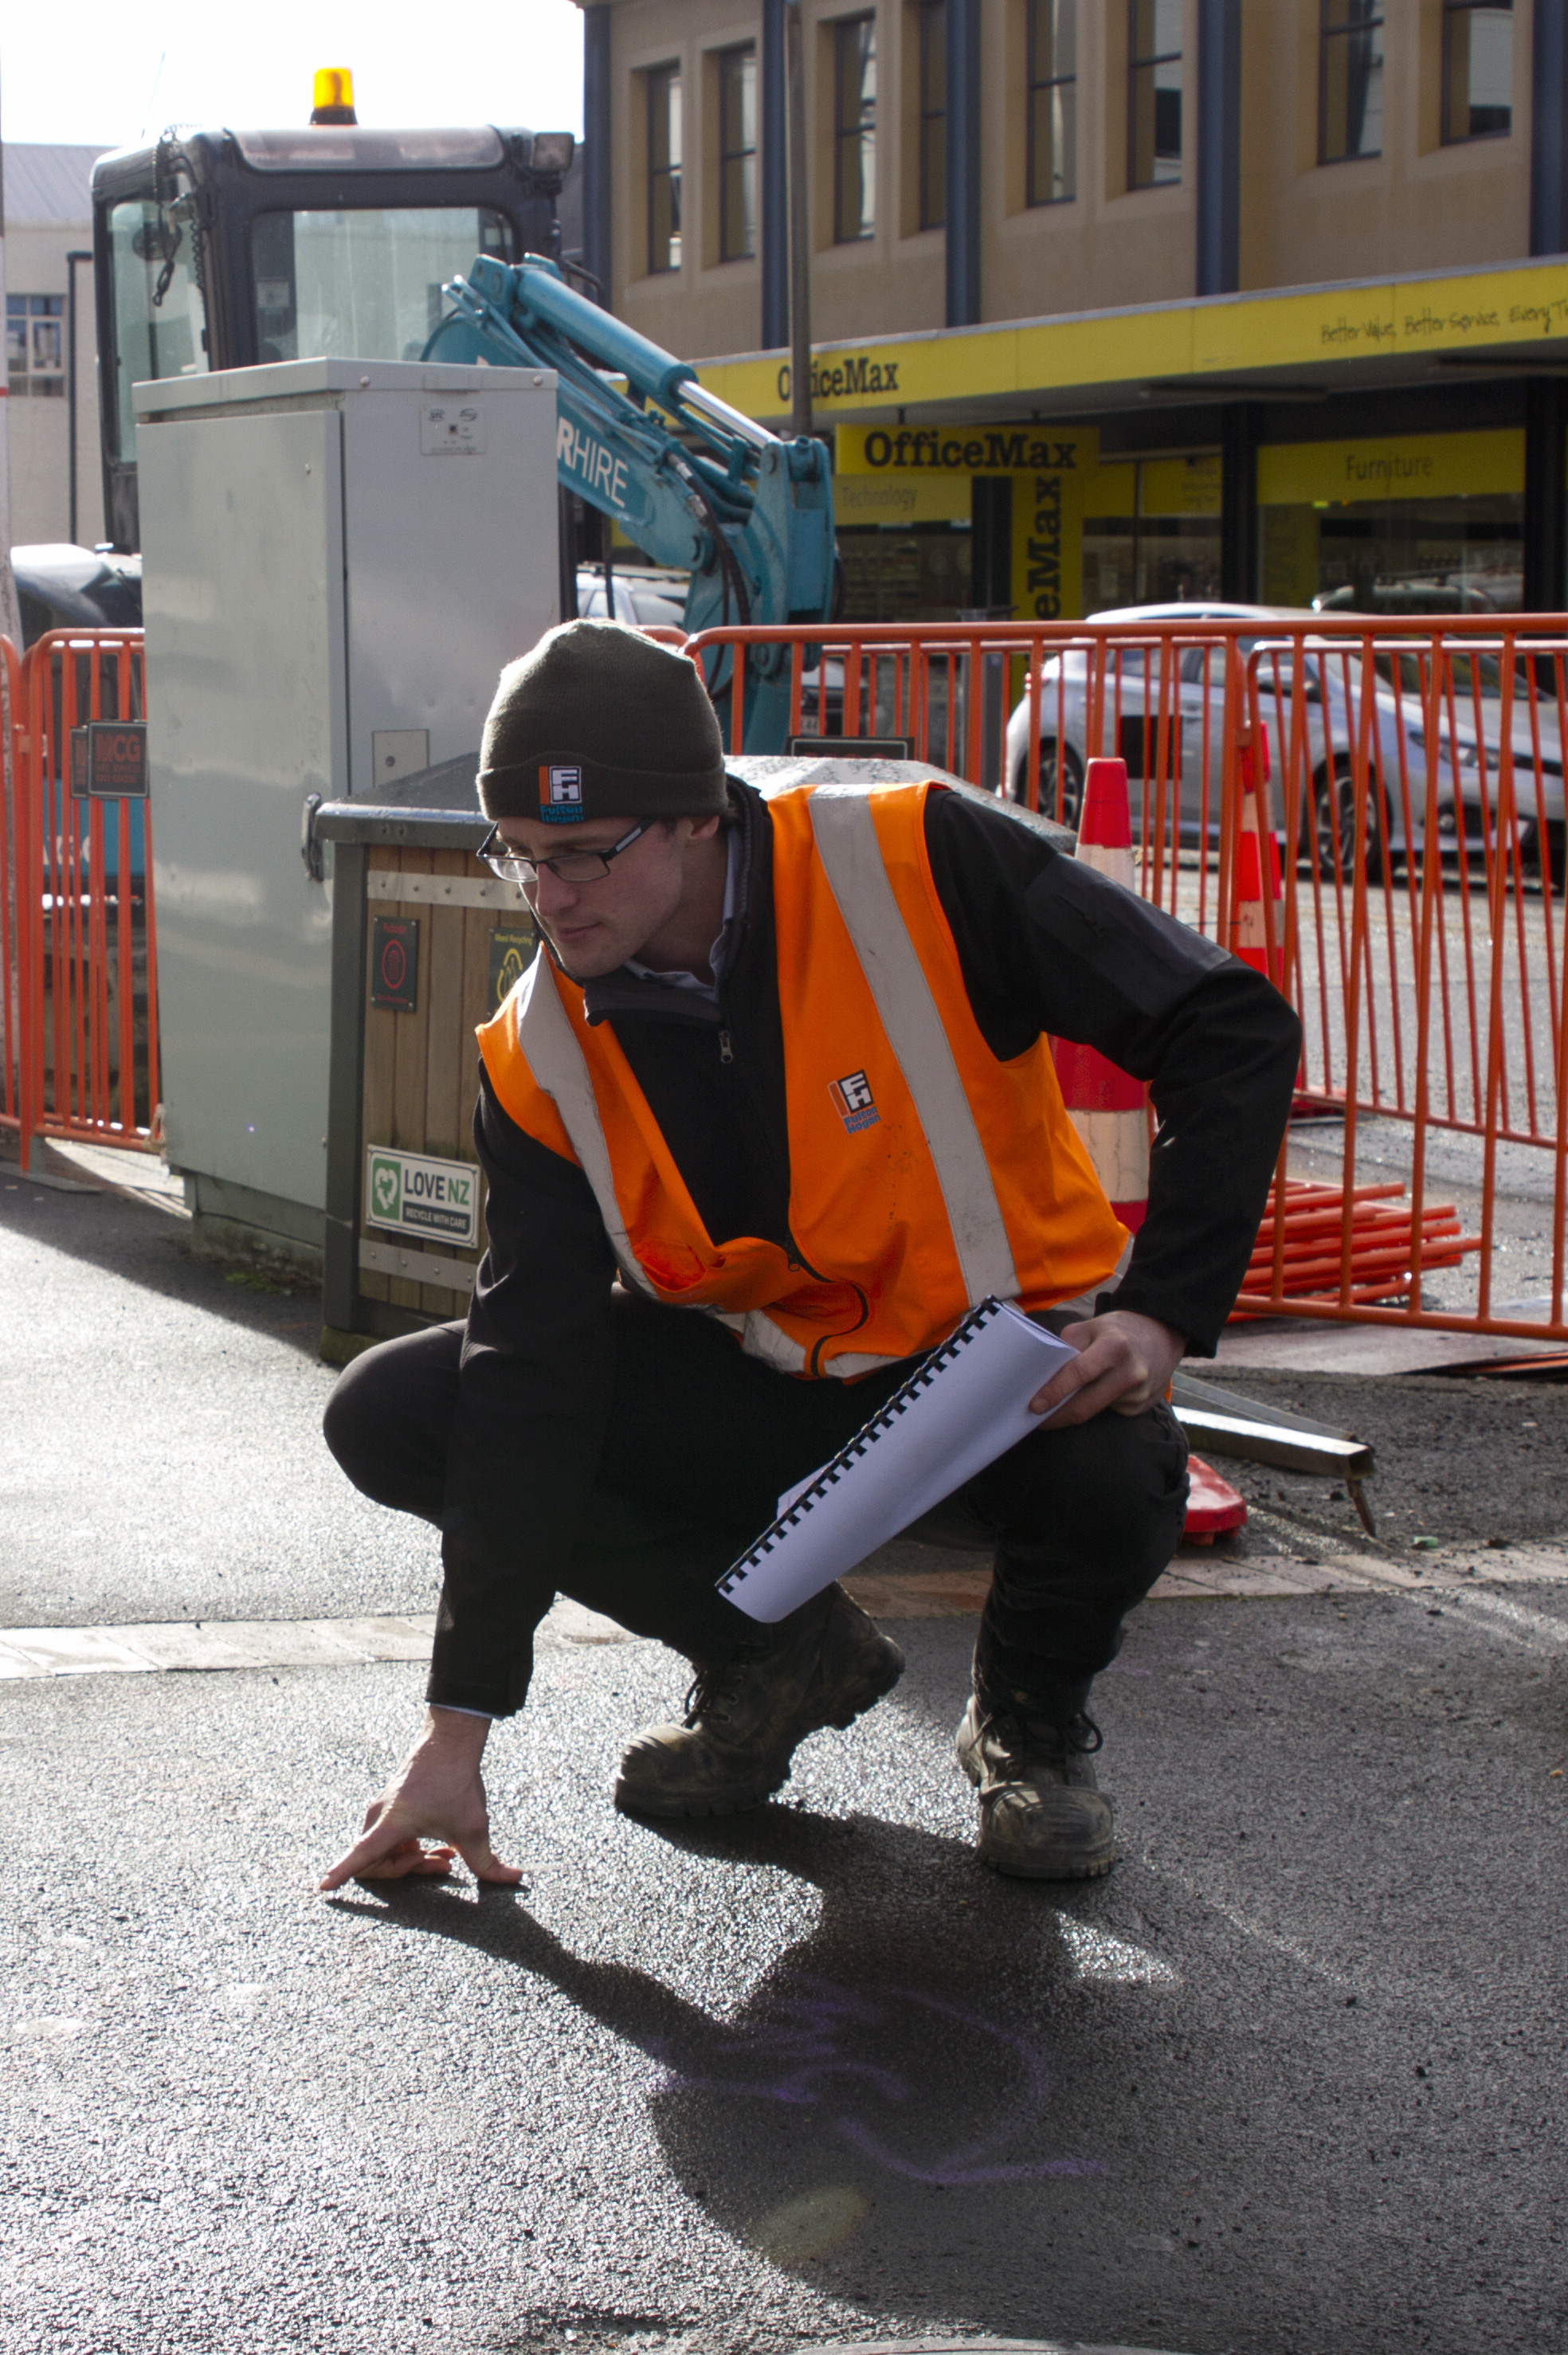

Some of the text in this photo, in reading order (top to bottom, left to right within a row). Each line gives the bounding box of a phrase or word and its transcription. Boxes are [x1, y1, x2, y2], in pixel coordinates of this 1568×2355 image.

[1321, 315, 1359, 344] Better
[1404, 307, 1446, 335] Better
[1509, 304, 1552, 334] Every
[778, 357, 900, 402] OiceMax
[864, 429, 1076, 468] OfficeMax
[1346, 454, 1433, 481] Furniture
[540, 805, 583, 814] Fulton
[843, 1105, 878, 1127] Fulton
[847, 1114, 880, 1134] Hogan
[405, 1170, 471, 1205] LOVE NZ
[406, 1207, 432, 1221] RECYCLE
[450, 1216, 467, 1229] CARE
